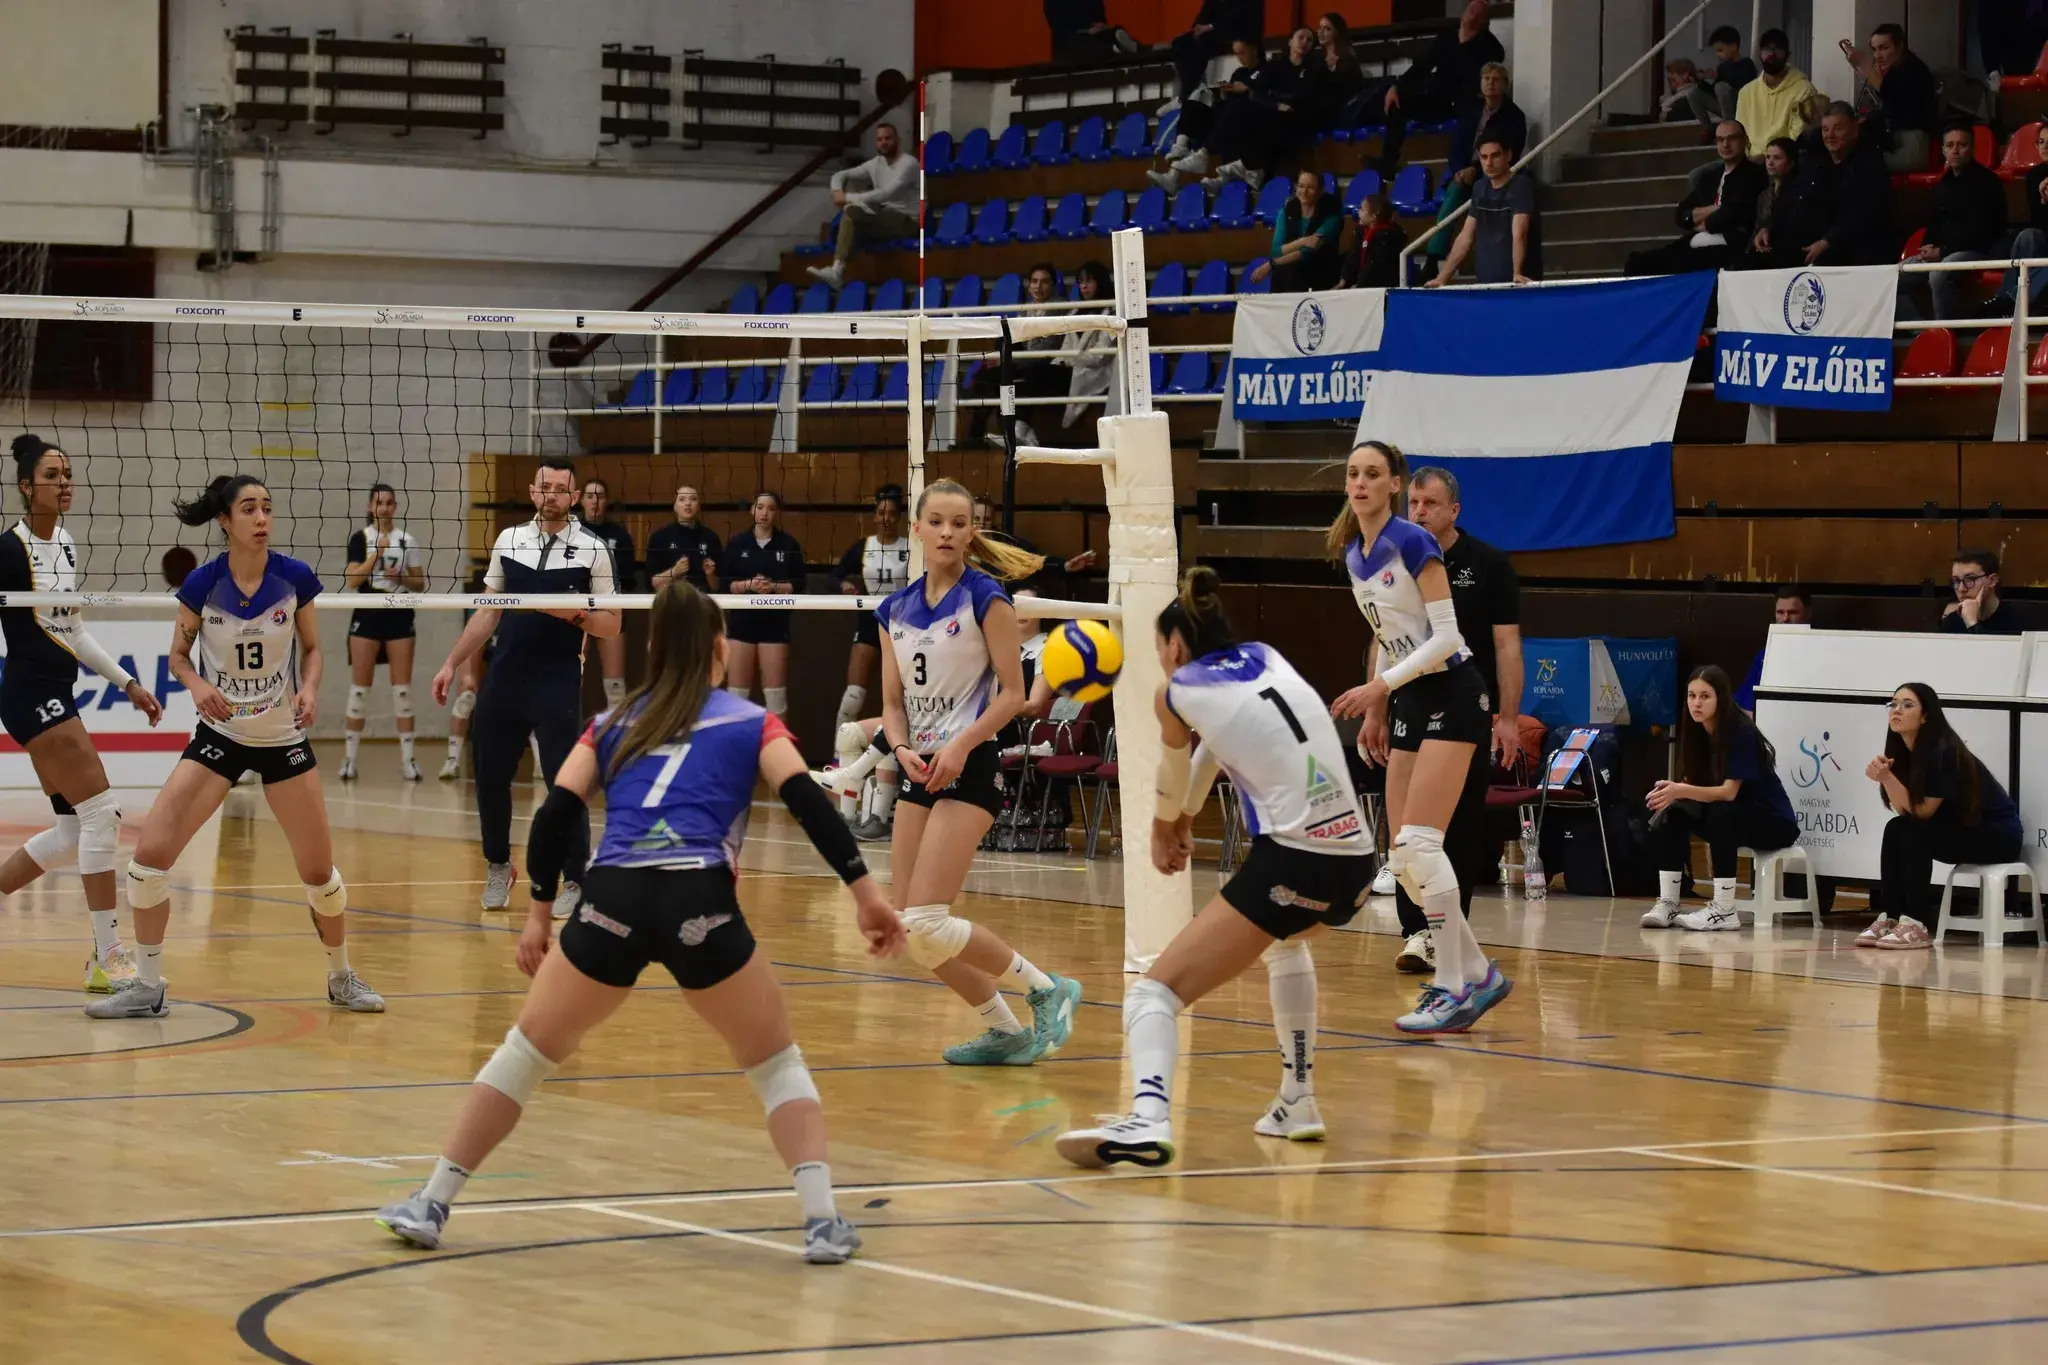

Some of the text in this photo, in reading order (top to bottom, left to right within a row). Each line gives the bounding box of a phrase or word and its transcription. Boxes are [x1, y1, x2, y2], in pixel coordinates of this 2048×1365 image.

[176, 307, 225, 315] FOXCONN
[467, 315, 514, 323] FOXCONN
[1718, 339, 1885, 394] MÁV ELŐRE
[1237, 363, 1295, 406] MÁV
[877, 568, 893, 584] 11
[750, 598, 795, 606] FOXCONN
[234, 641, 264, 670] 13
[216, 670, 283, 692] FATUM
[912, 652, 927, 686] 3
[35, 698, 65, 724] 13
[904, 695, 955, 713] ATUM
[1258, 686, 1308, 744] 1
[642, 743, 692, 808] 7
[1799, 798, 1831, 808] MAGYAR
[1796, 811, 1859, 835] PLABDA
